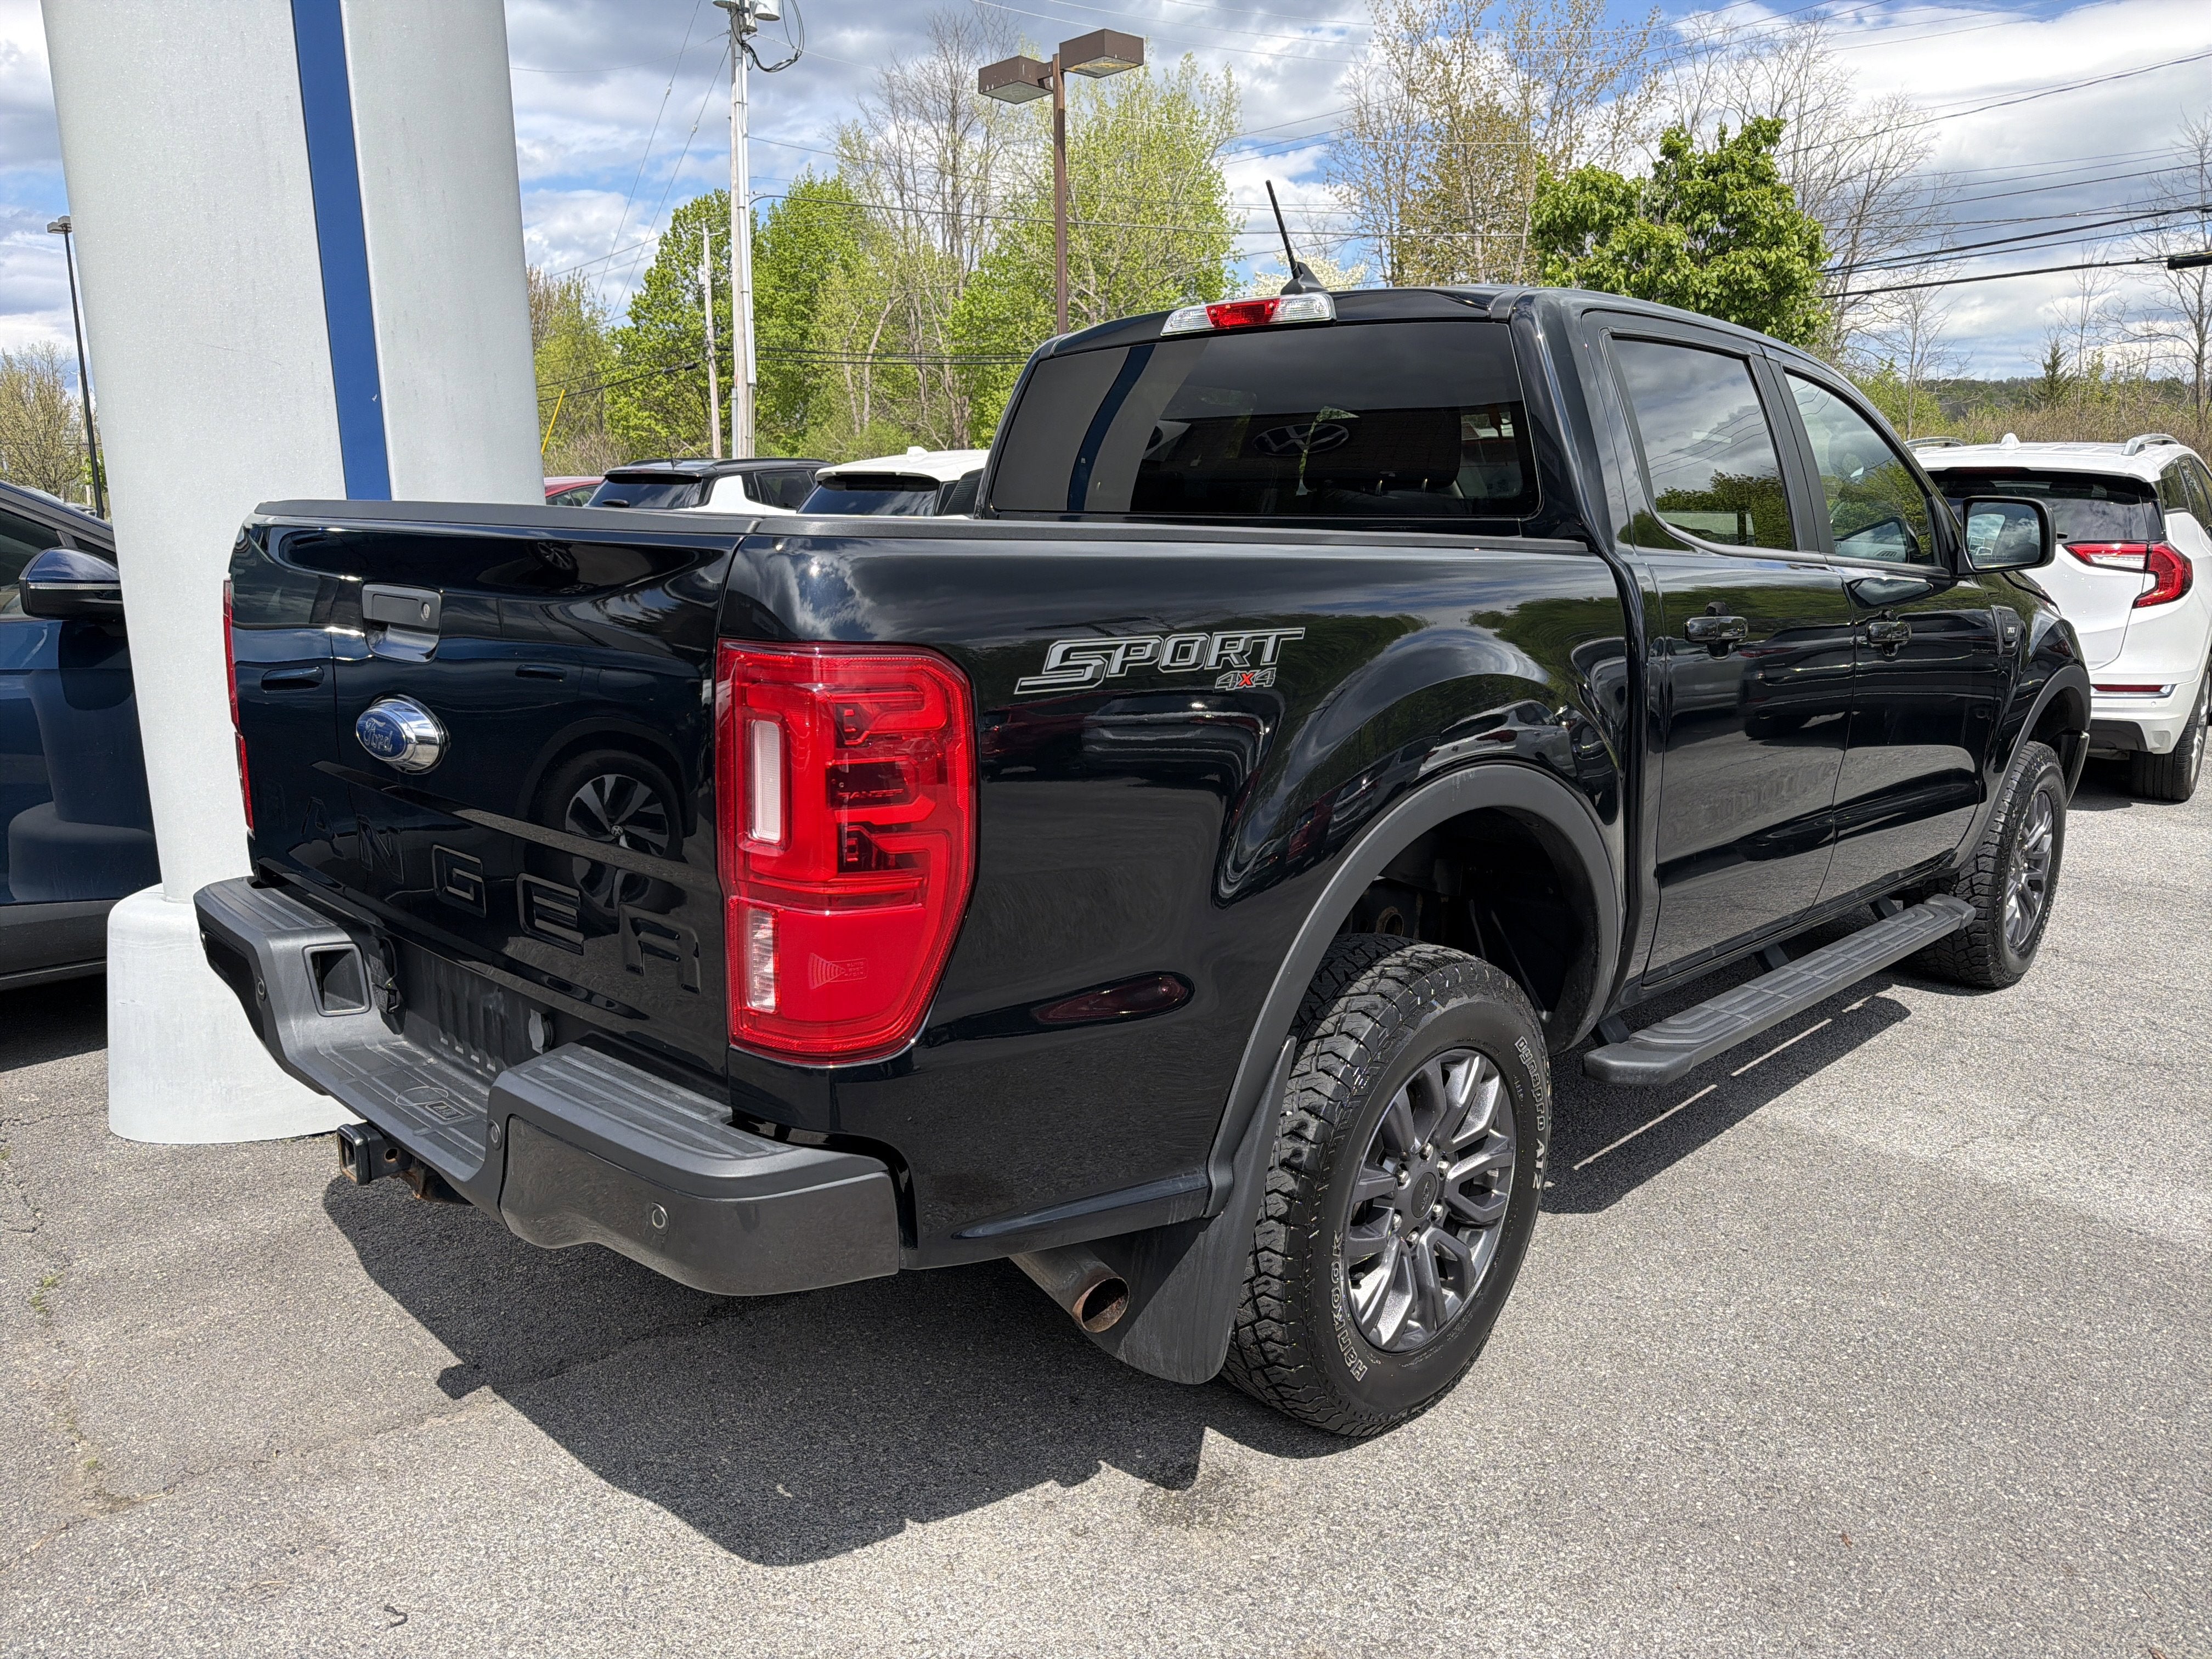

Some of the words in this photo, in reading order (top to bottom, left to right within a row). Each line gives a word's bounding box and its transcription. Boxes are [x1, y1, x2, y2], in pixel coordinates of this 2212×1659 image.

[1014, 627, 1306, 695] SPORT
[363, 716, 393, 752] Ford
[256, 779, 701, 995] RANGER
